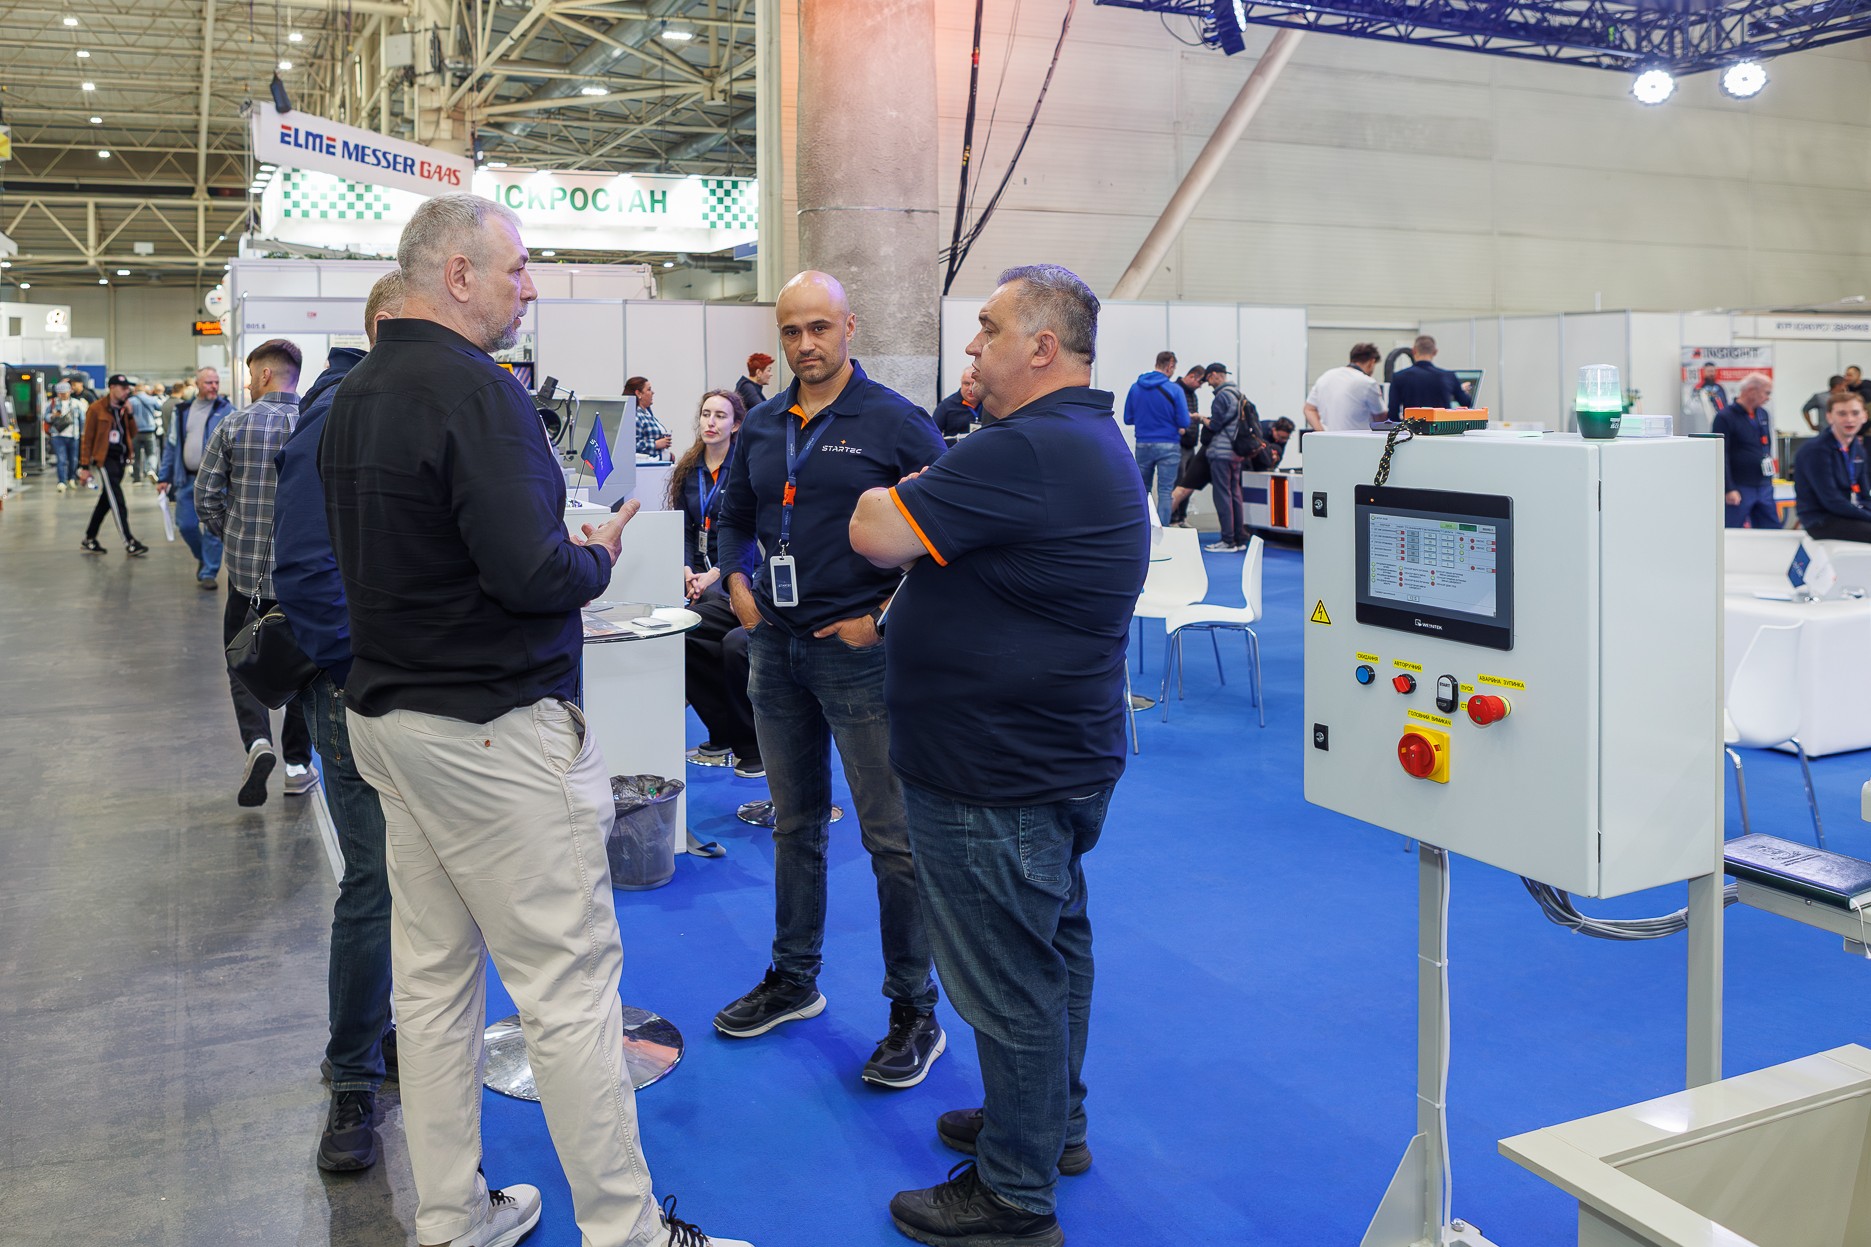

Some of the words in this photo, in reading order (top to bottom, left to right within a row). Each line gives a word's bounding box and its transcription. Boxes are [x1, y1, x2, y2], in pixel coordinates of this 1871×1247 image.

[280, 124, 337, 156] ELME
[341, 140, 416, 176] MESSER
[419, 160, 461, 186] GAAS
[821, 444, 863, 454] STARTEC
